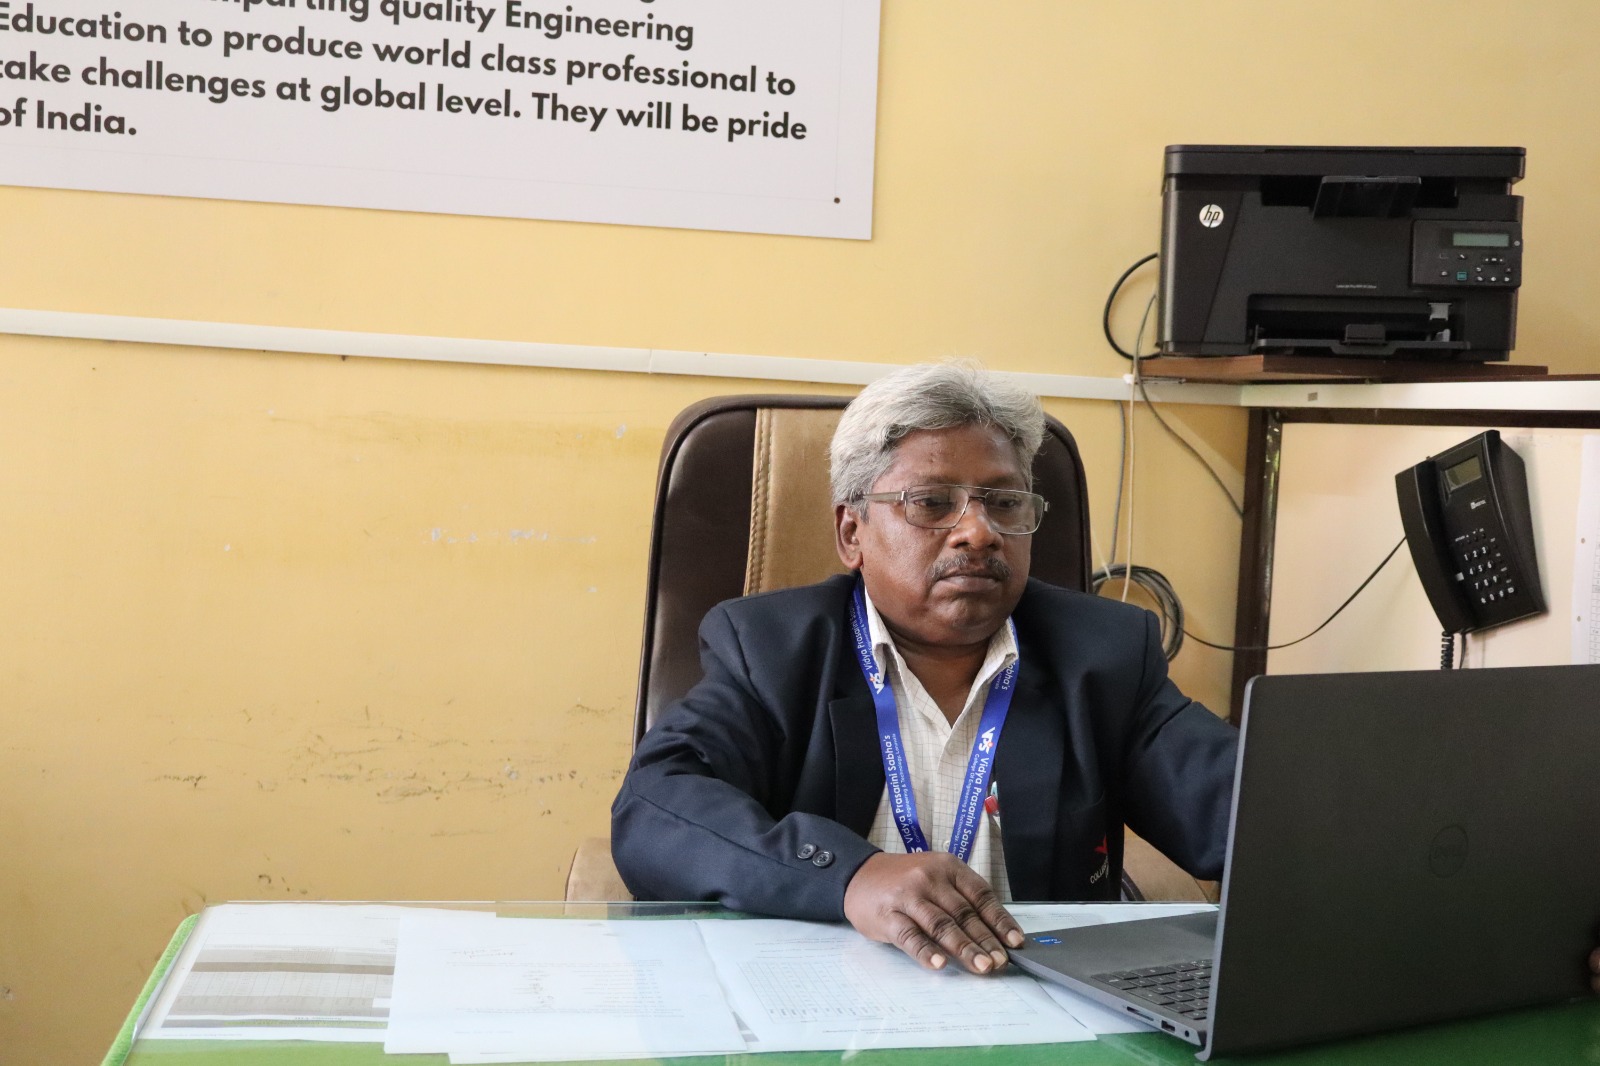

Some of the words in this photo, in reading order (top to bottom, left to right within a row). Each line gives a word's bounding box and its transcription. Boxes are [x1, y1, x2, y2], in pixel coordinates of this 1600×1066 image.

[380, 0, 497, 33] quality
[505, 0, 694, 52] Engineering
[178, 21, 213, 47] to
[223, 26, 363, 60] produce
[373, 38, 471, 69] world
[481, 43, 557, 76] class
[566, 53, 757, 93] professional
[766, 71, 796, 96] to
[0, 50, 71, 83] ake
[81, 56, 266, 104] challenges
[276, 78, 311, 101] at
[320, 76, 426, 113] global
[436, 83, 521, 118] level.
[531, 92, 608, 132] They
[615, 101, 672, 130] will
[681, 103, 719, 133] be
[728, 110, 807, 143] pride
[36, 99, 137, 136] India.
[1202, 204, 1222, 228] hp
[860, 648, 873, 671] Vidya
[884, 735, 897, 772] Sabha's
[978, 727, 995, 754] VPS
[975, 757, 990, 785] Vidya
[888, 773, 904, 814] Prasarini
[903, 788, 912, 818] Engineering
[966, 786, 982, 828] Prasarini
[899, 815, 913, 844] Vidya
